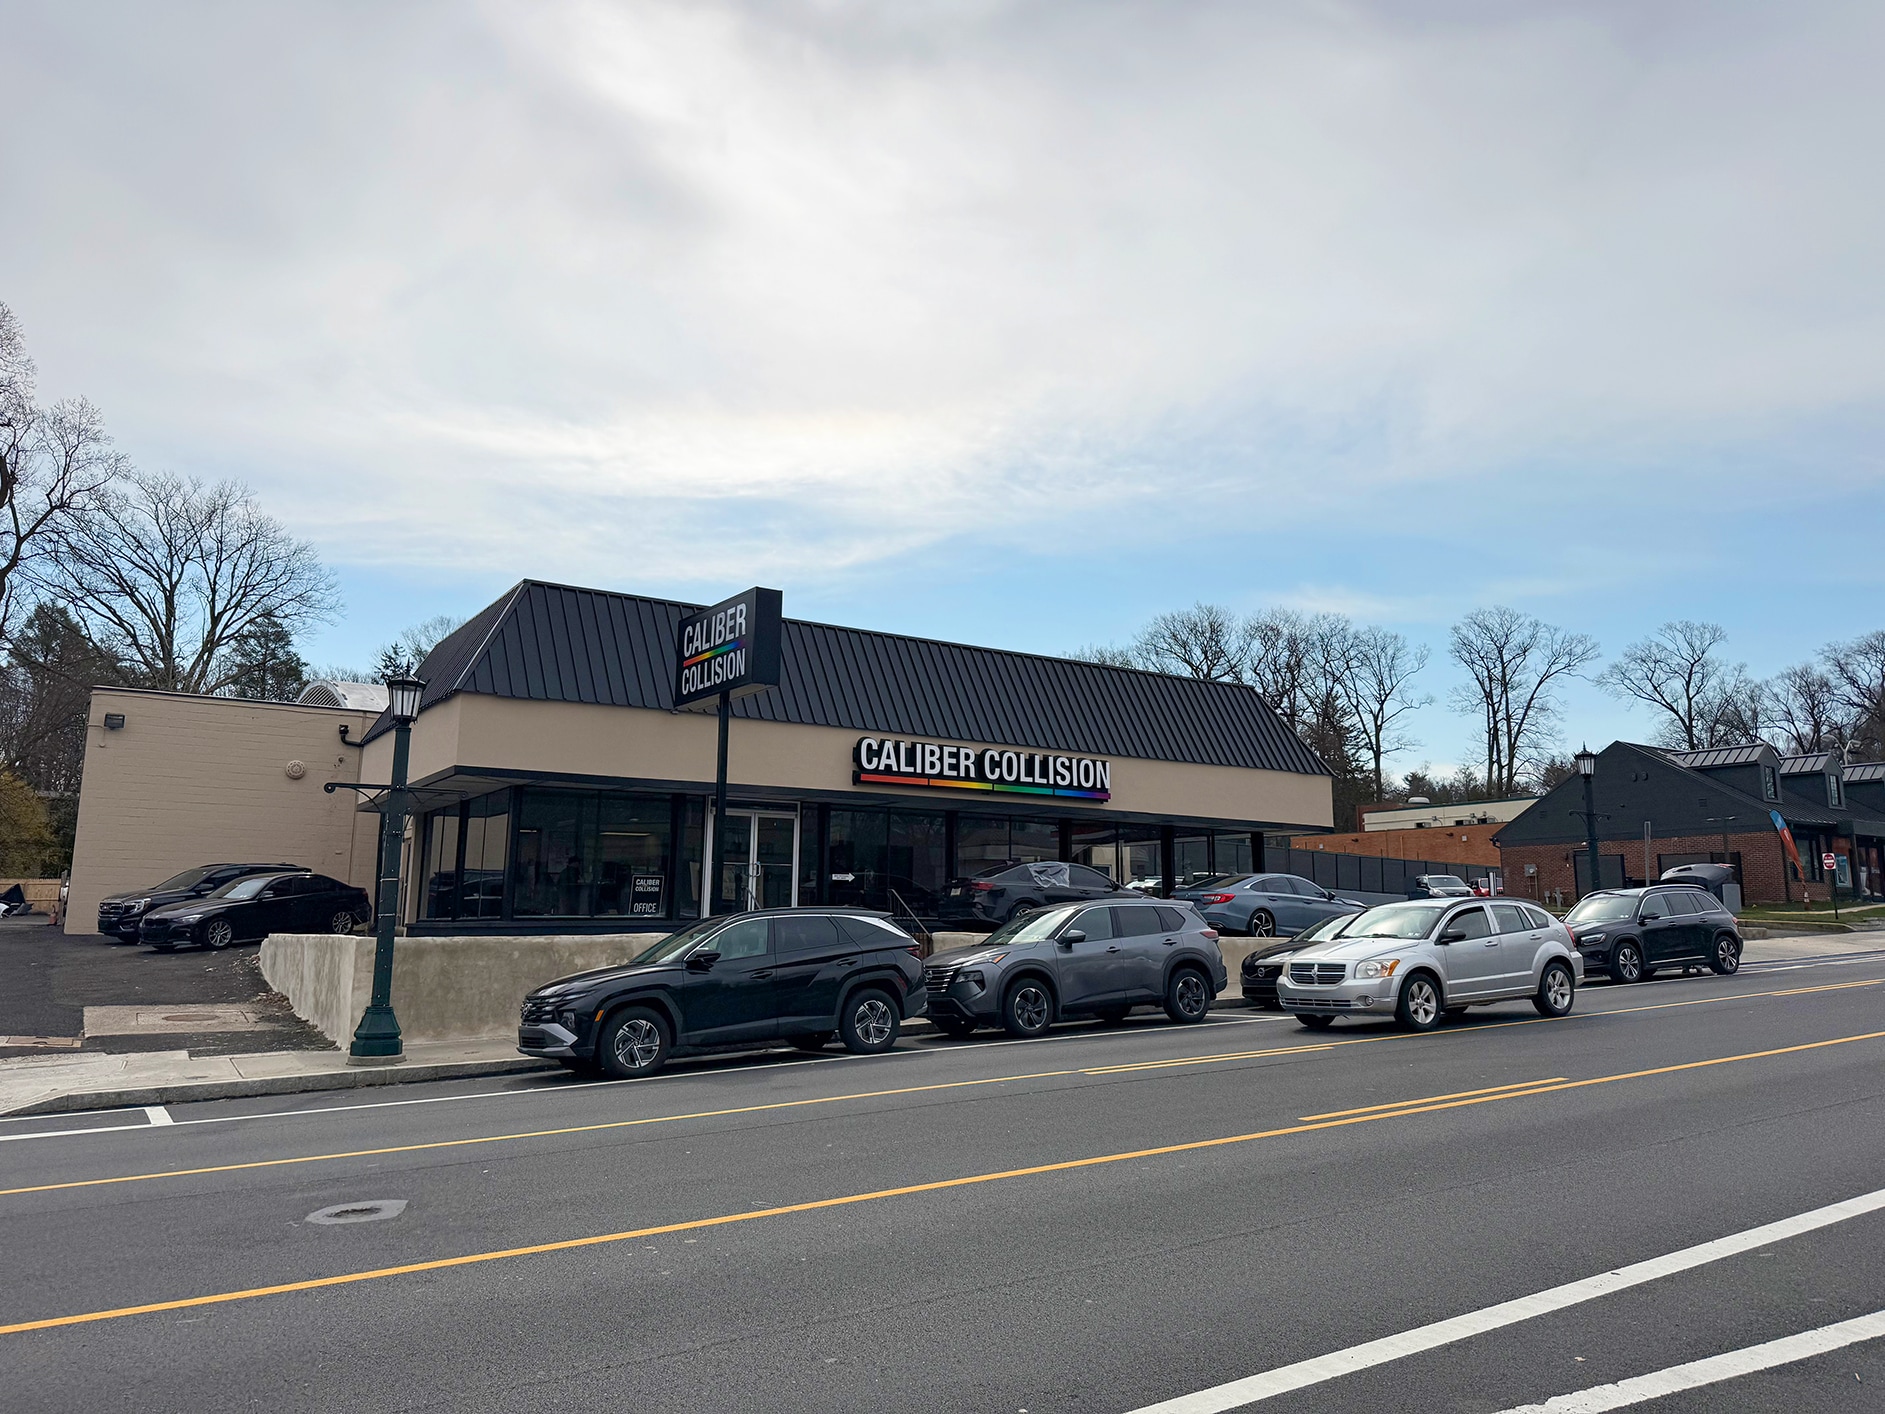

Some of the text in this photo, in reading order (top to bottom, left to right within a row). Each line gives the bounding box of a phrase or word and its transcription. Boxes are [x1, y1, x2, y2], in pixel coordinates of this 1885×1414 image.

[683, 603, 747, 657] CALIBER
[682, 648, 746, 695] COLLISION
[860, 738, 1111, 789] CALIBER COLLISION
[634, 903, 656, 912] OFFICE
